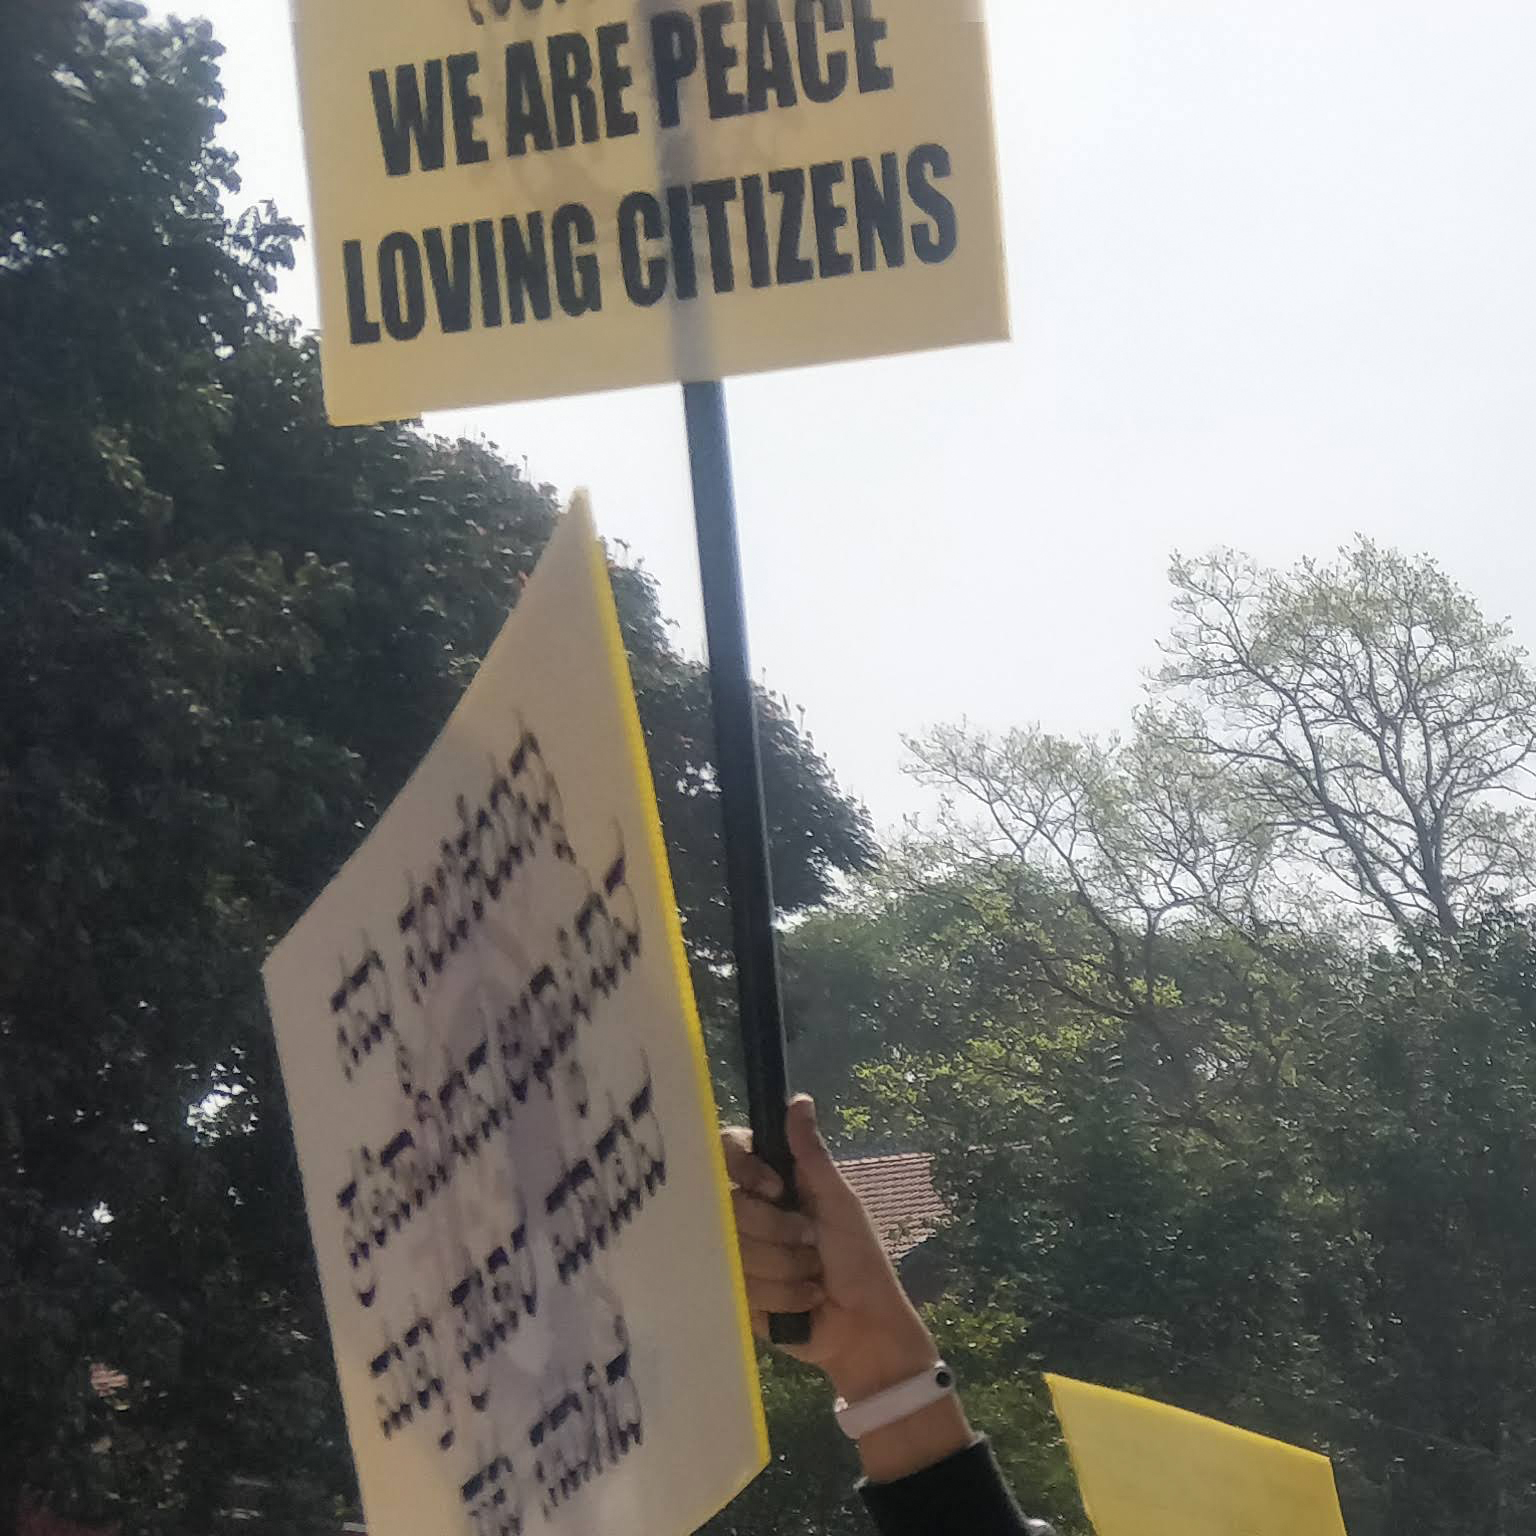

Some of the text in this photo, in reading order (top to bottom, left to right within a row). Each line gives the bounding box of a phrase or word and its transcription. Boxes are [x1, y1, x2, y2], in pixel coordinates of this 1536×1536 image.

[370, 0, 894, 176] WE ARE PEACE
[343, 143, 958, 345] LOVING CITIZENS
